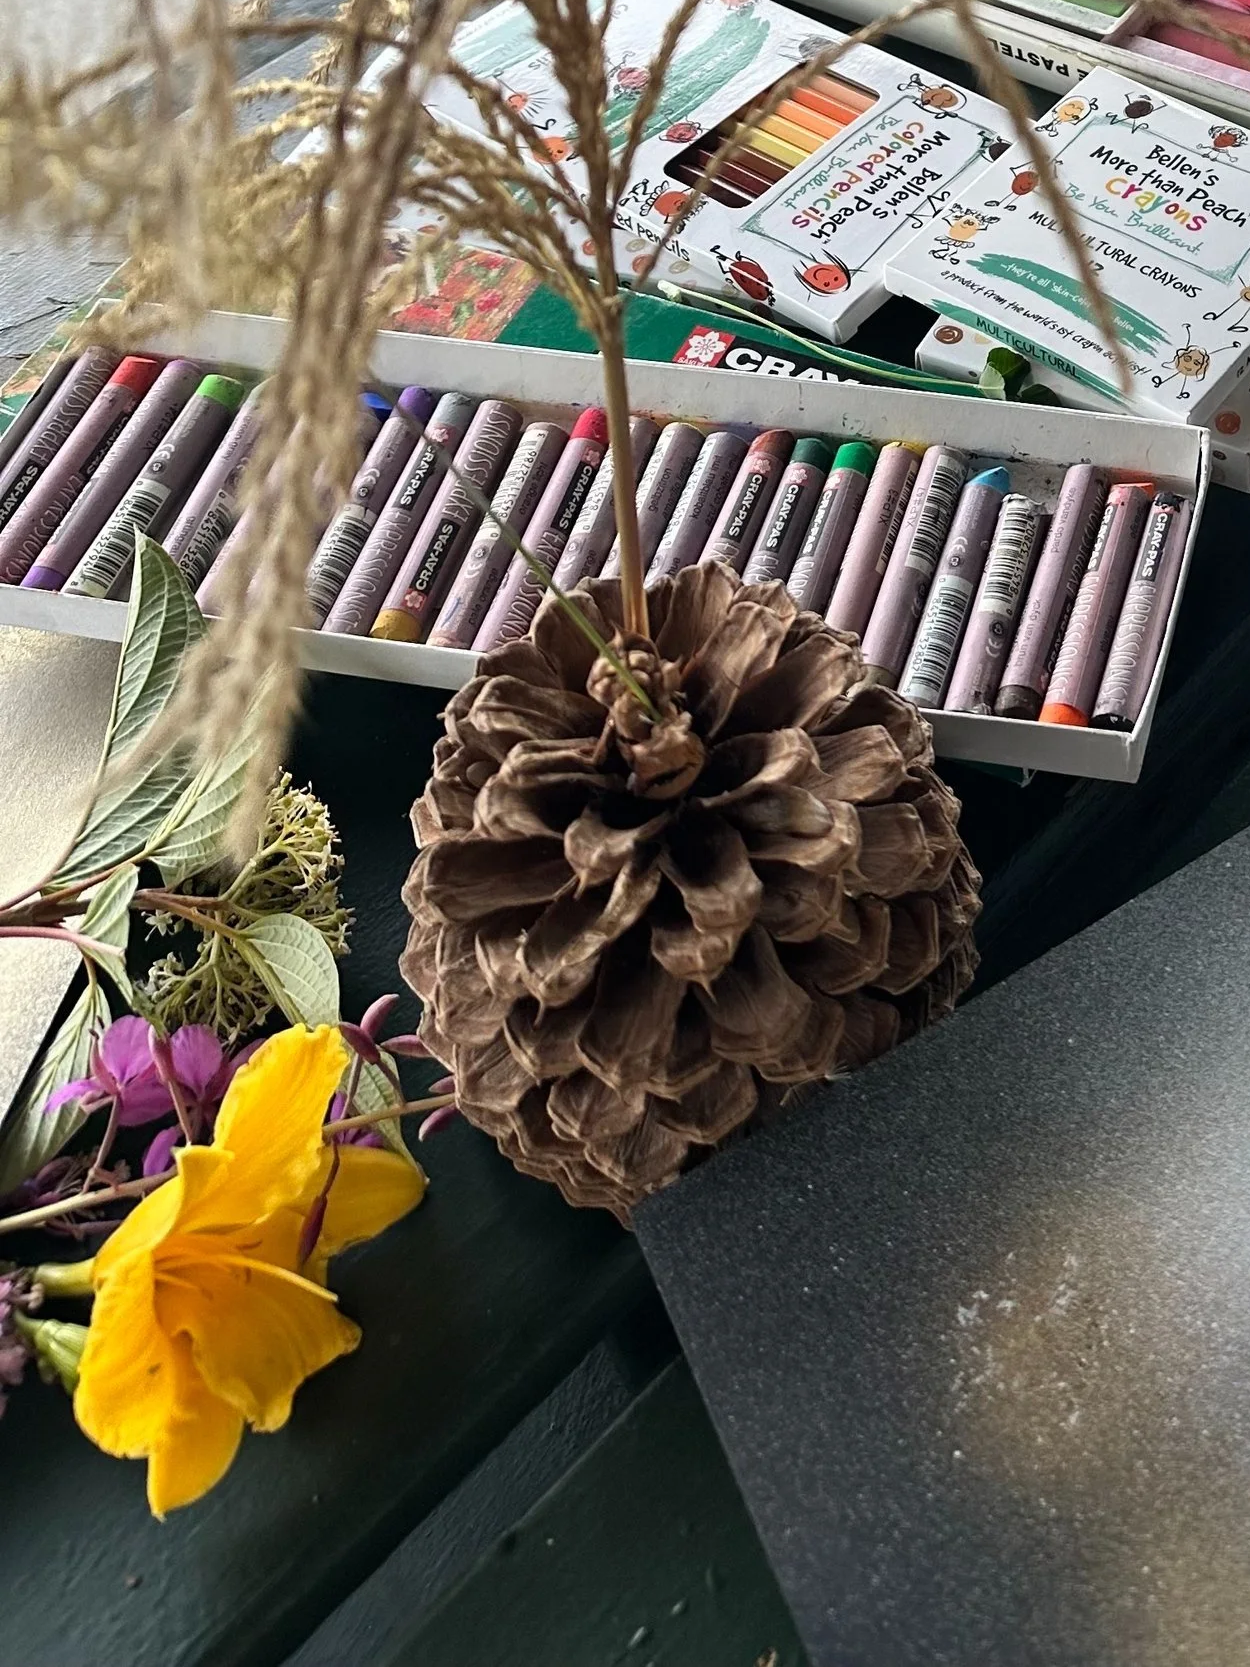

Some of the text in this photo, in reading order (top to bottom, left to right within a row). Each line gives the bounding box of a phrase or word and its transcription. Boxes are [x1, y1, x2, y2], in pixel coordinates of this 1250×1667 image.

[901, 130, 951, 165] More
[1090, 145, 1138, 176] More
[1137, 169, 1184, 198] than
[1145, 144, 1220, 187] Bellen's
[863, 162, 907, 196] than
[872, 166, 943, 220] Bellen's
[946, 272, 984, 296] product
[983, 289, 1008, 305] from
[1004, 301, 1026, 319] the
[975, 315, 1083, 381] MULTICULTURAL
[558, 464, 593, 531] CRAY-PAS
[728, 473, 763, 538] CRAY-PAS
[765, 484, 800, 549] CRAY-PAS
[802, 490, 833, 555] CRAY-PAS
[415, 522, 455, 591] CRAY-PAS
[1050, 527, 1064, 555] pardo
[1086, 505, 1114, 571] CRAY-PAS
[1100, 512, 1169, 708] CRAY-PAS EXPRESSIONIST
[1014, 643, 1027, 668] brun
[1022, 624, 1034, 645] van
